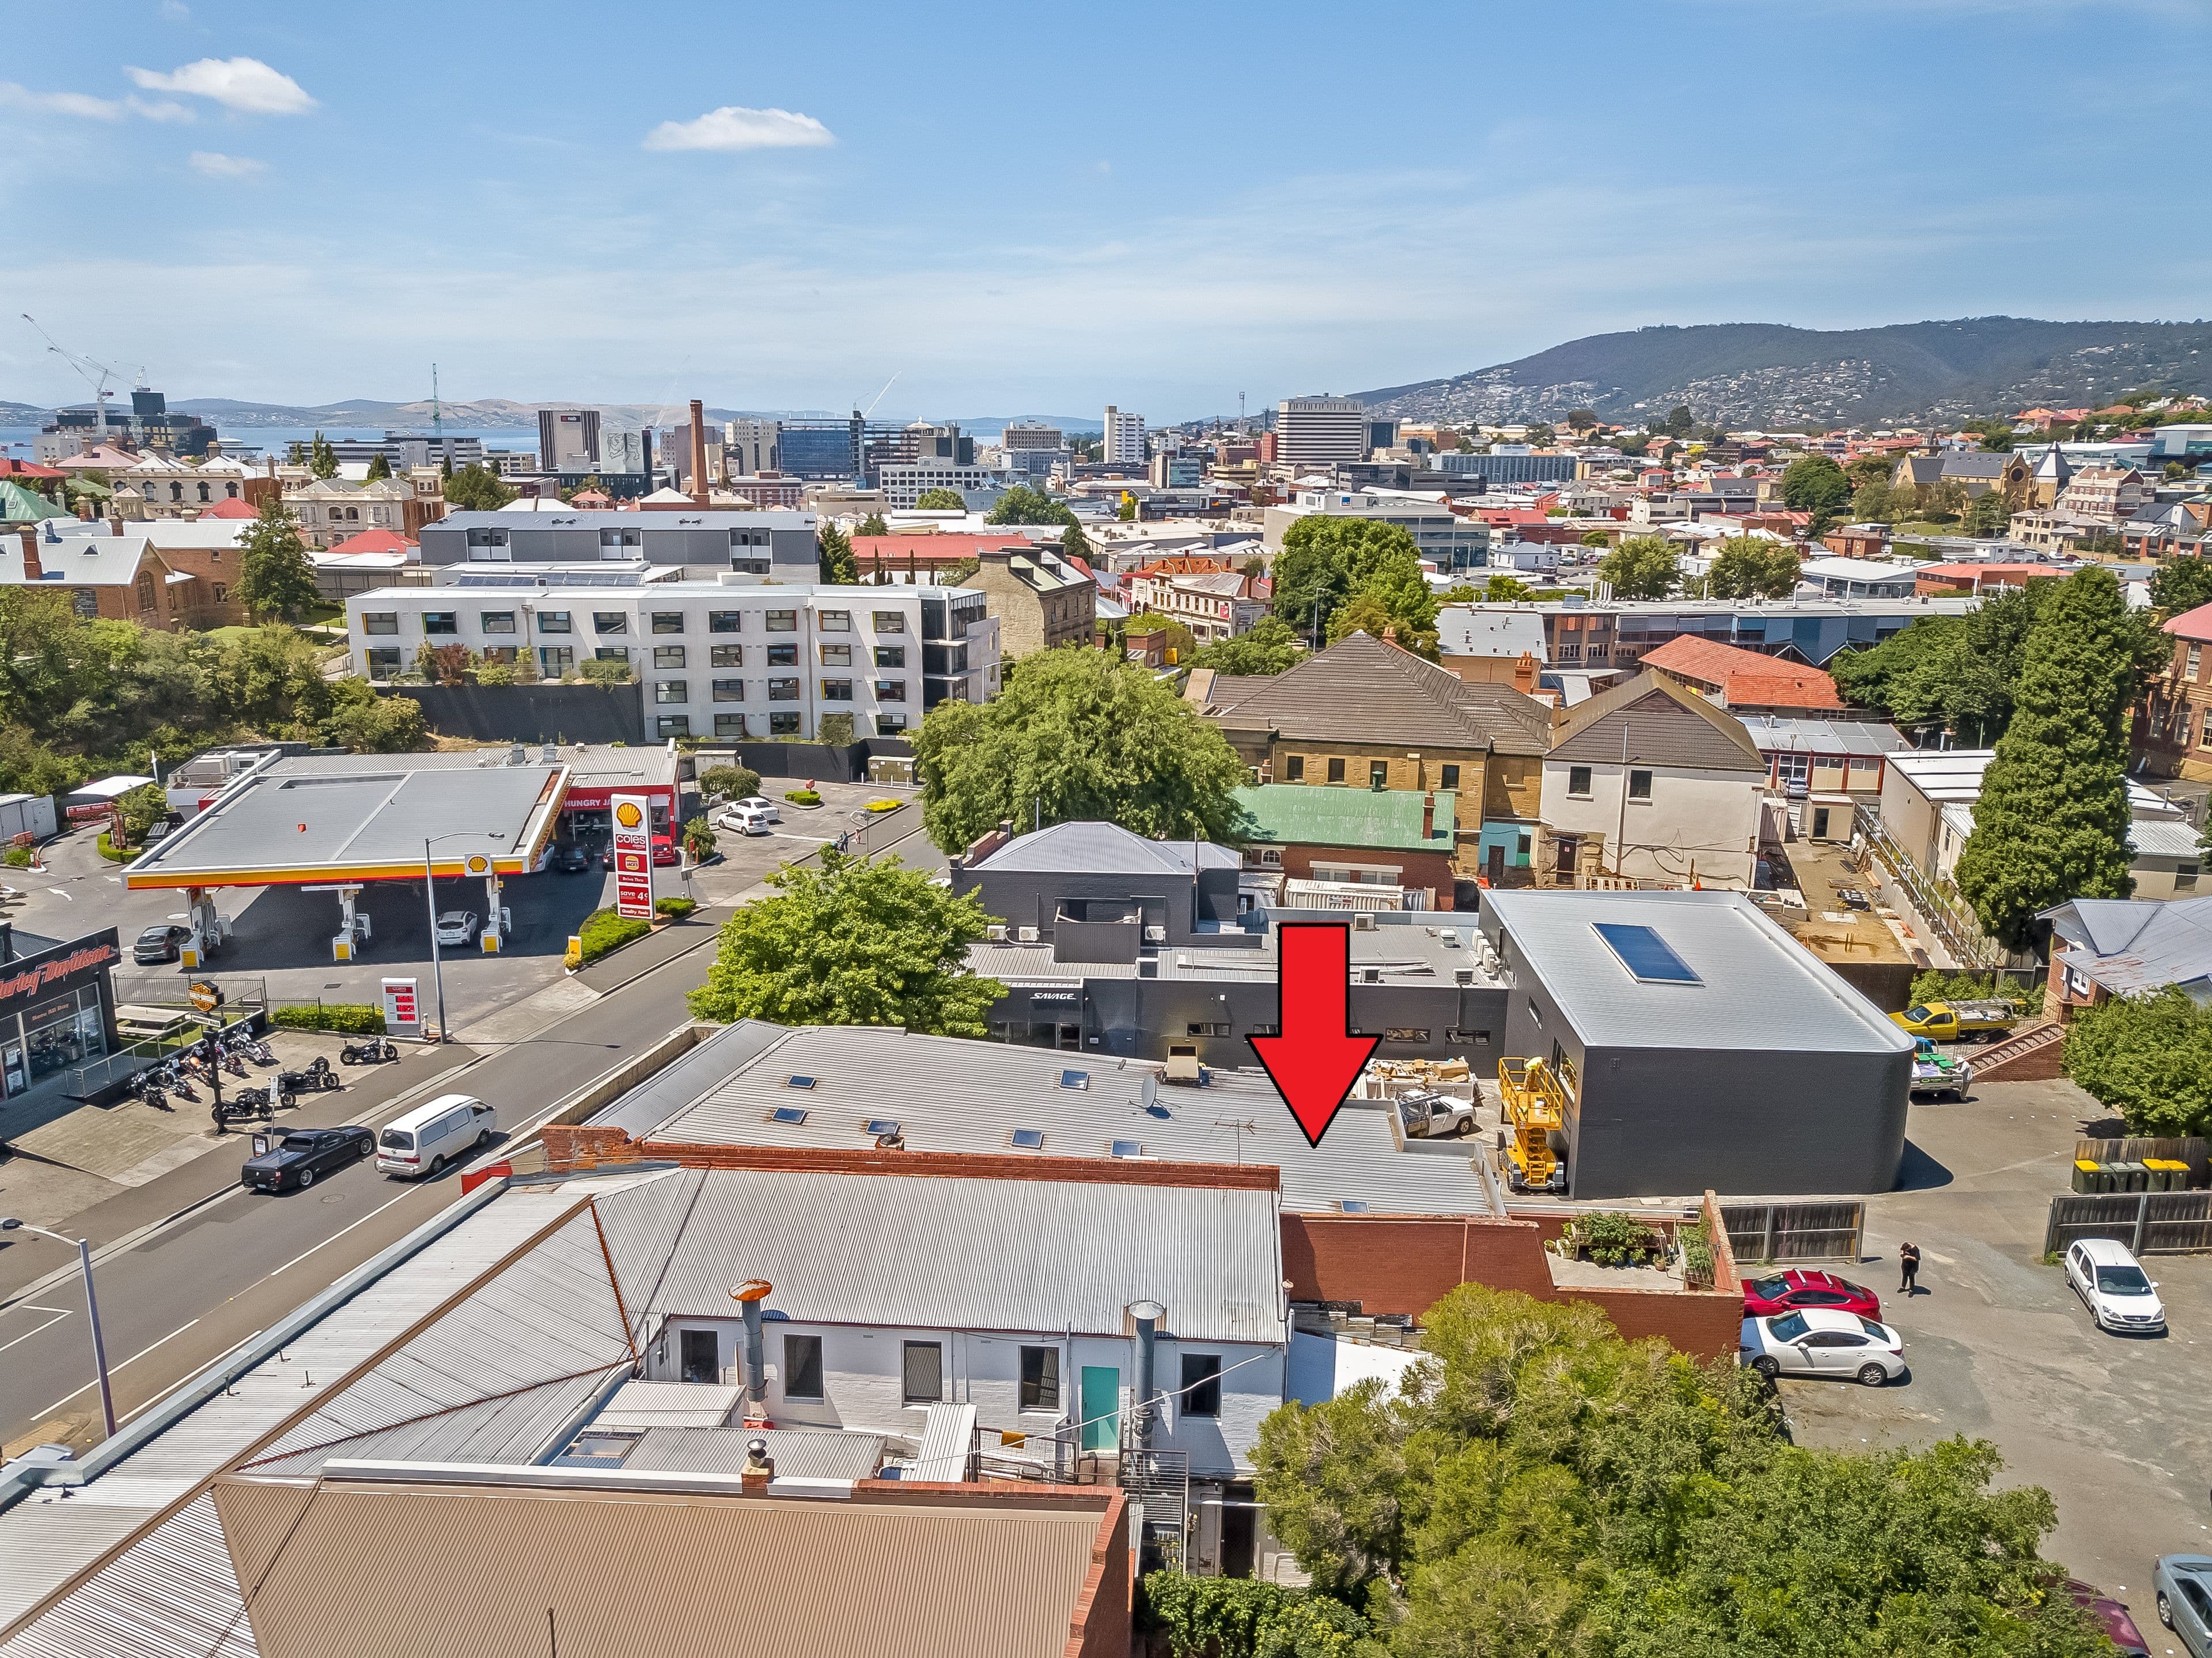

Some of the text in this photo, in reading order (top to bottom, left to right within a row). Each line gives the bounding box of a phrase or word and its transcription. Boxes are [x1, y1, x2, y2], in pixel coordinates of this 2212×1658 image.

[565, 799, 601, 807] HUNGRY
[616, 835, 646, 844] coles
[0, 945, 115, 999] arley-Davidson
